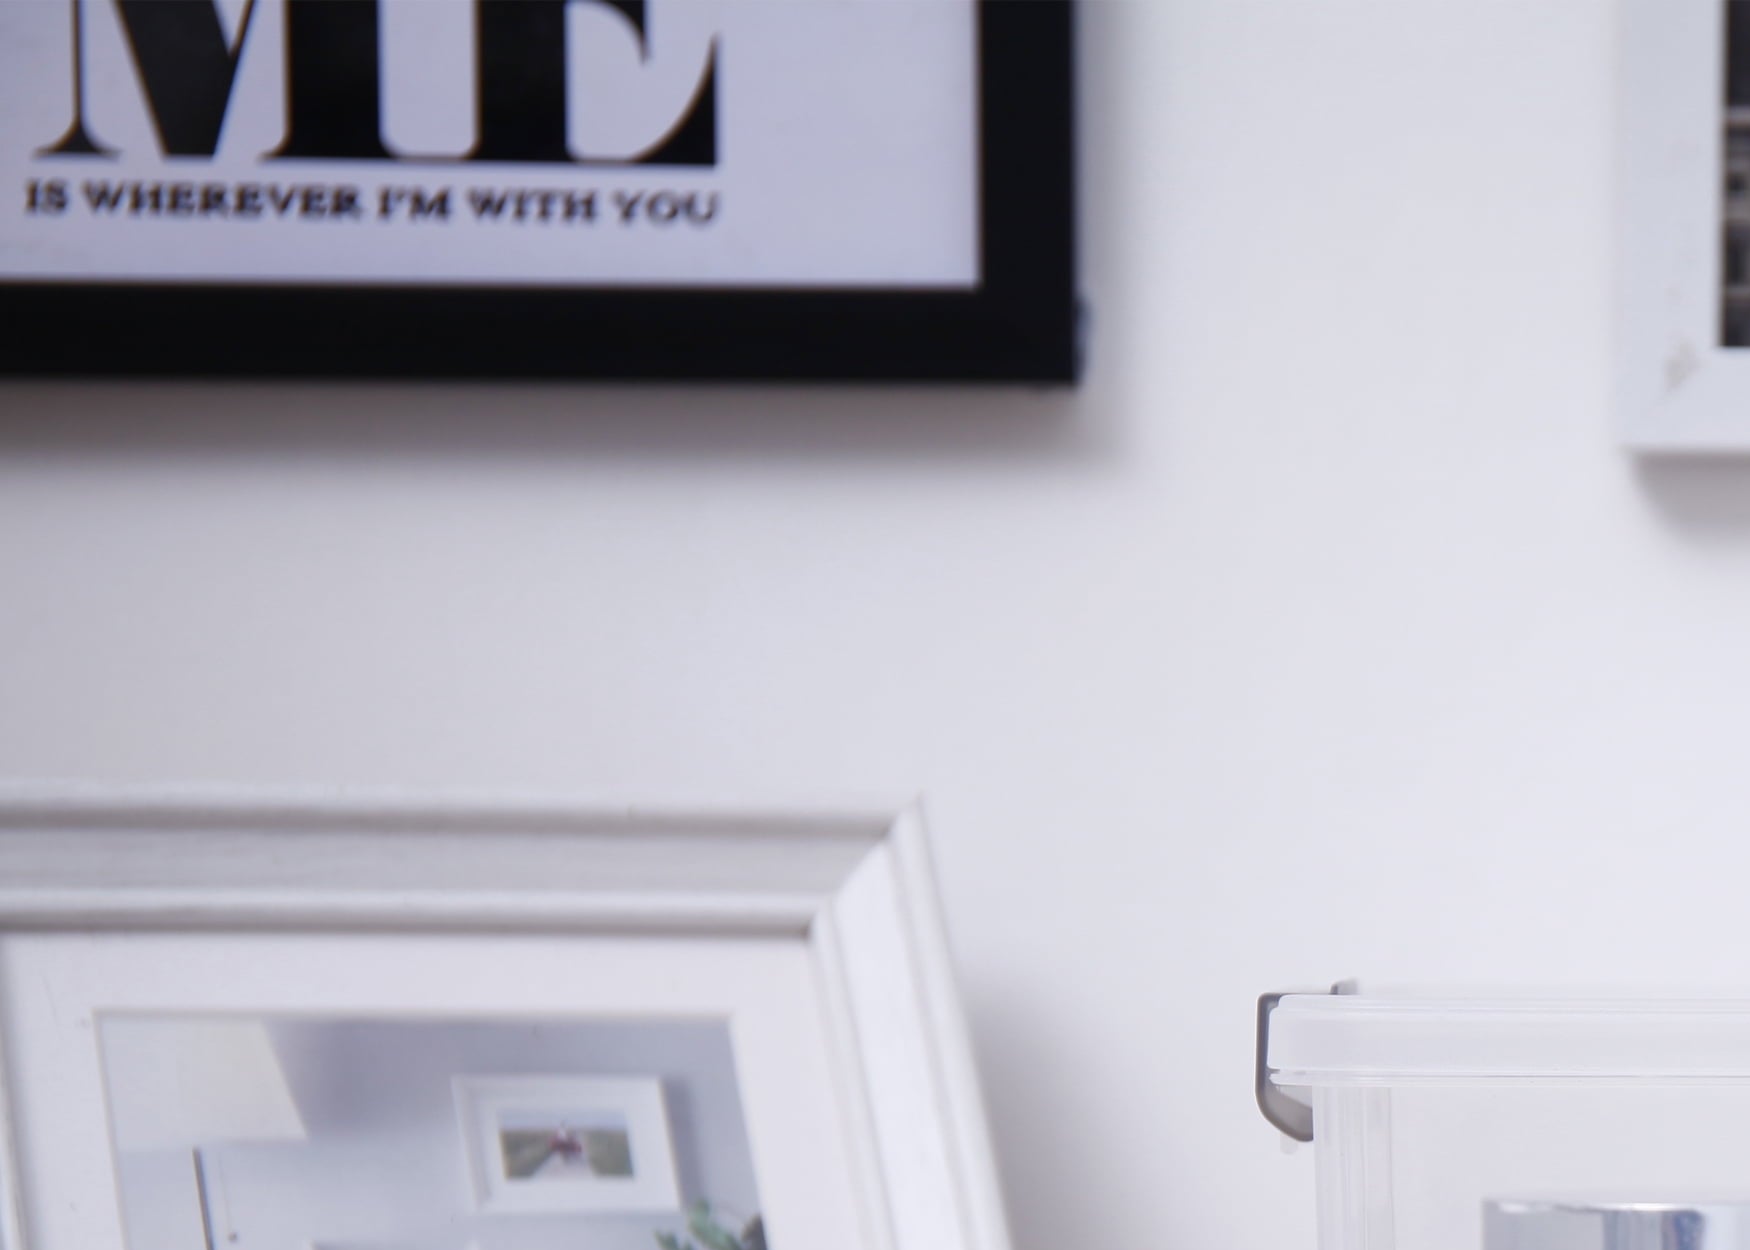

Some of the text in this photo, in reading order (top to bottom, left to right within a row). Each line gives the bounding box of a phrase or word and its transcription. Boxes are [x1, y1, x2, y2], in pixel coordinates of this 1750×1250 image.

[23, 178, 722, 229] IS WHEREVER I'M WITH YOU
